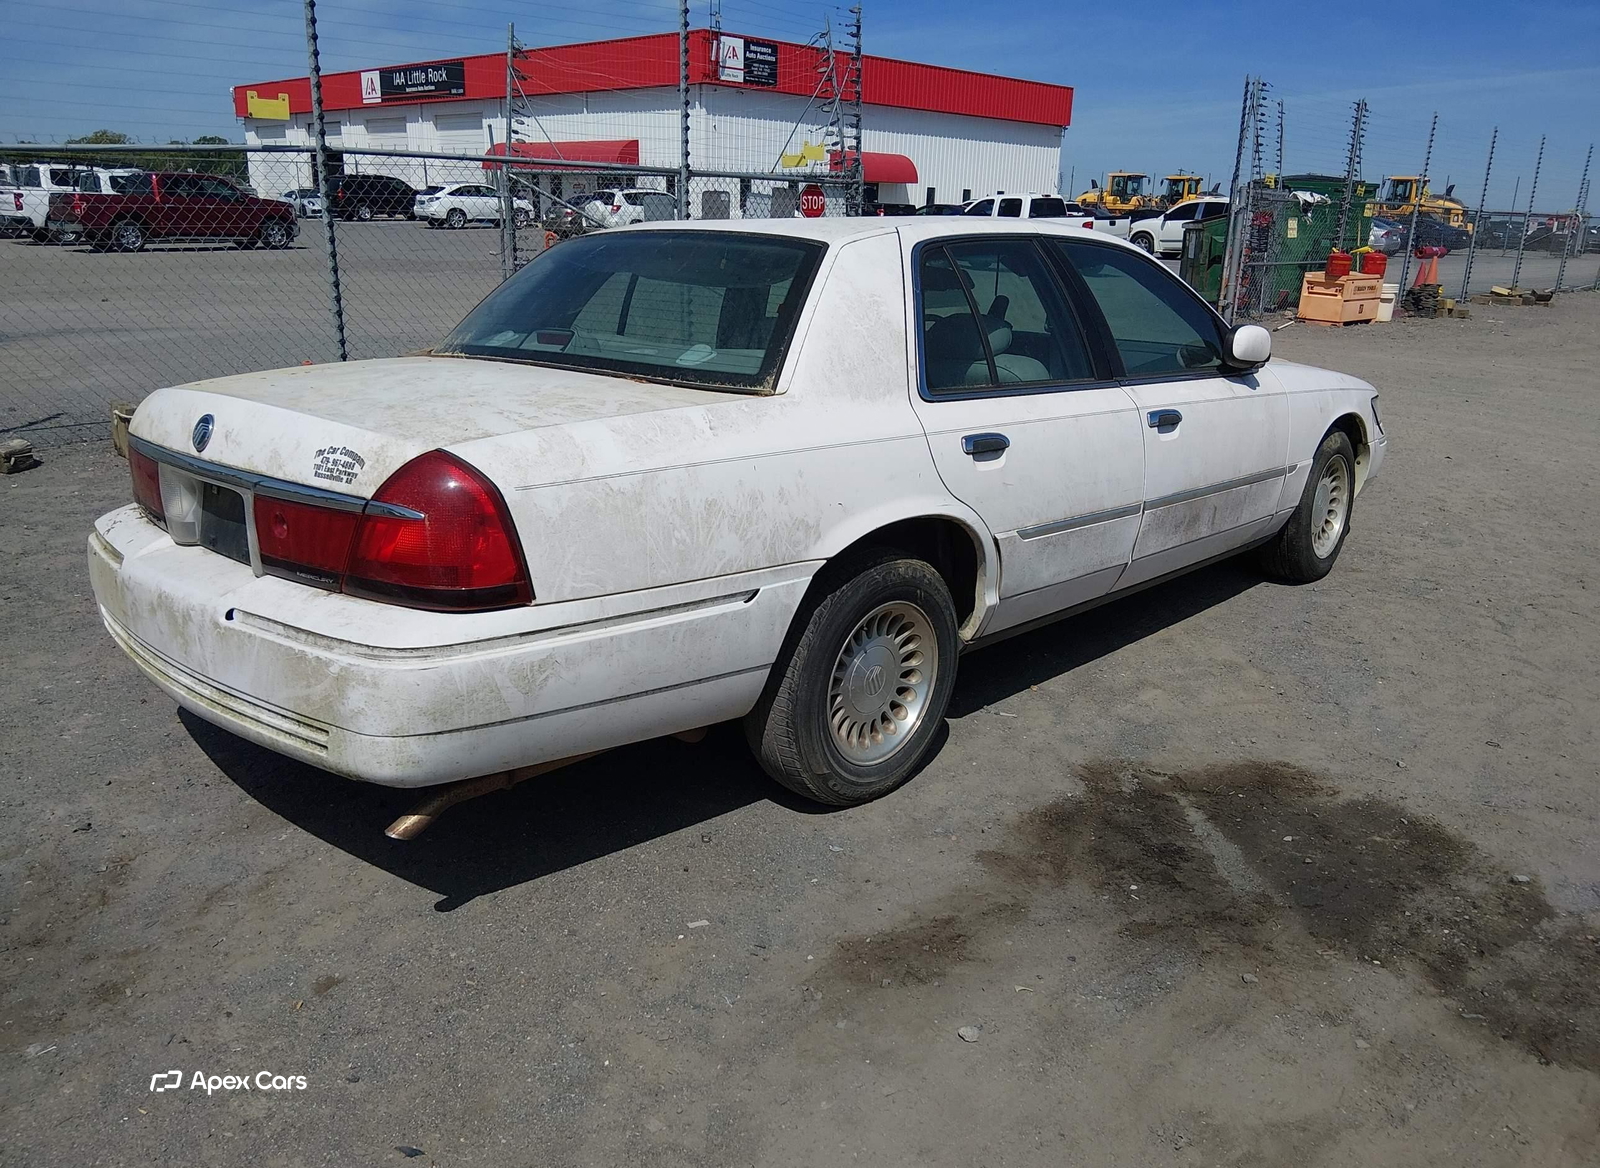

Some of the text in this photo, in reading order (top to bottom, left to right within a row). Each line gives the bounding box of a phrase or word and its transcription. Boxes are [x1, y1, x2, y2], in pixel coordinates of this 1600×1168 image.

[750, 43, 772, 54] Insurance
[746, 51, 776, 62] Auto Auctions
[393, 67, 448, 86] IAA Little Rock
[802, 195, 824, 210] STOP
[314, 446, 366, 470] The Car Company
[314, 470, 354, 485] Russellville AR
[324, 466, 335, 474] East
[335, 467, 359, 479] Parkway
[296, 571, 334, 584] MERCURY
